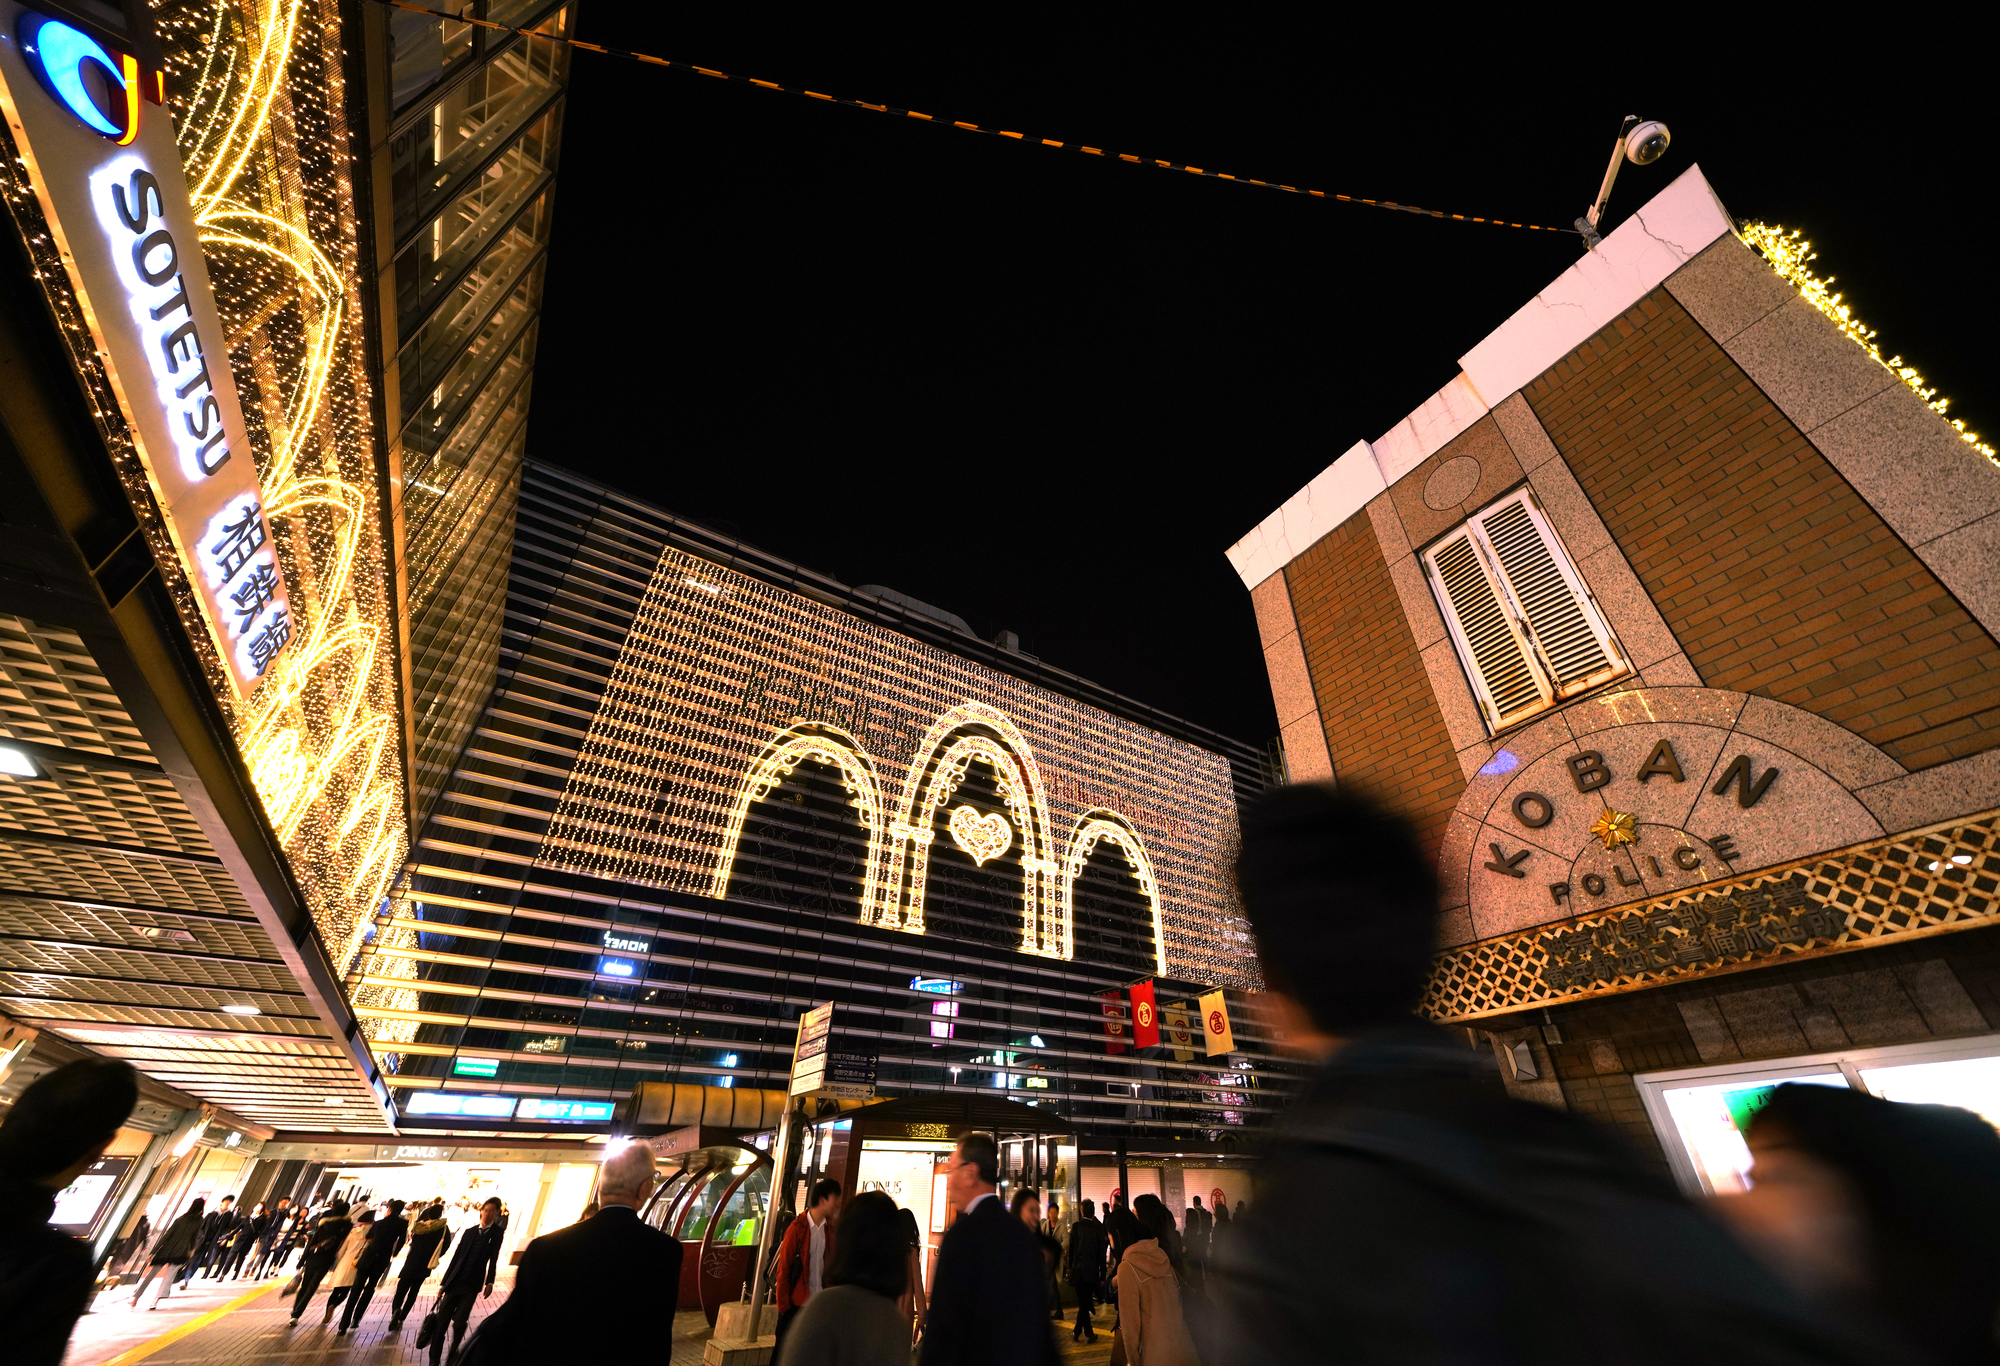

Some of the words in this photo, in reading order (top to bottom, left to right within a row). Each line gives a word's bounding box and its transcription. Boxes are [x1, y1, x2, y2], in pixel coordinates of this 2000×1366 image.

[111, 168, 232, 477] SOTETSU
[211, 502, 292, 676] 相鉄線
[1484, 739, 1778, 878] KOBAN
[1549, 834, 1740, 906] POLICE
[392, 1146, 437, 1160] JOINUS
